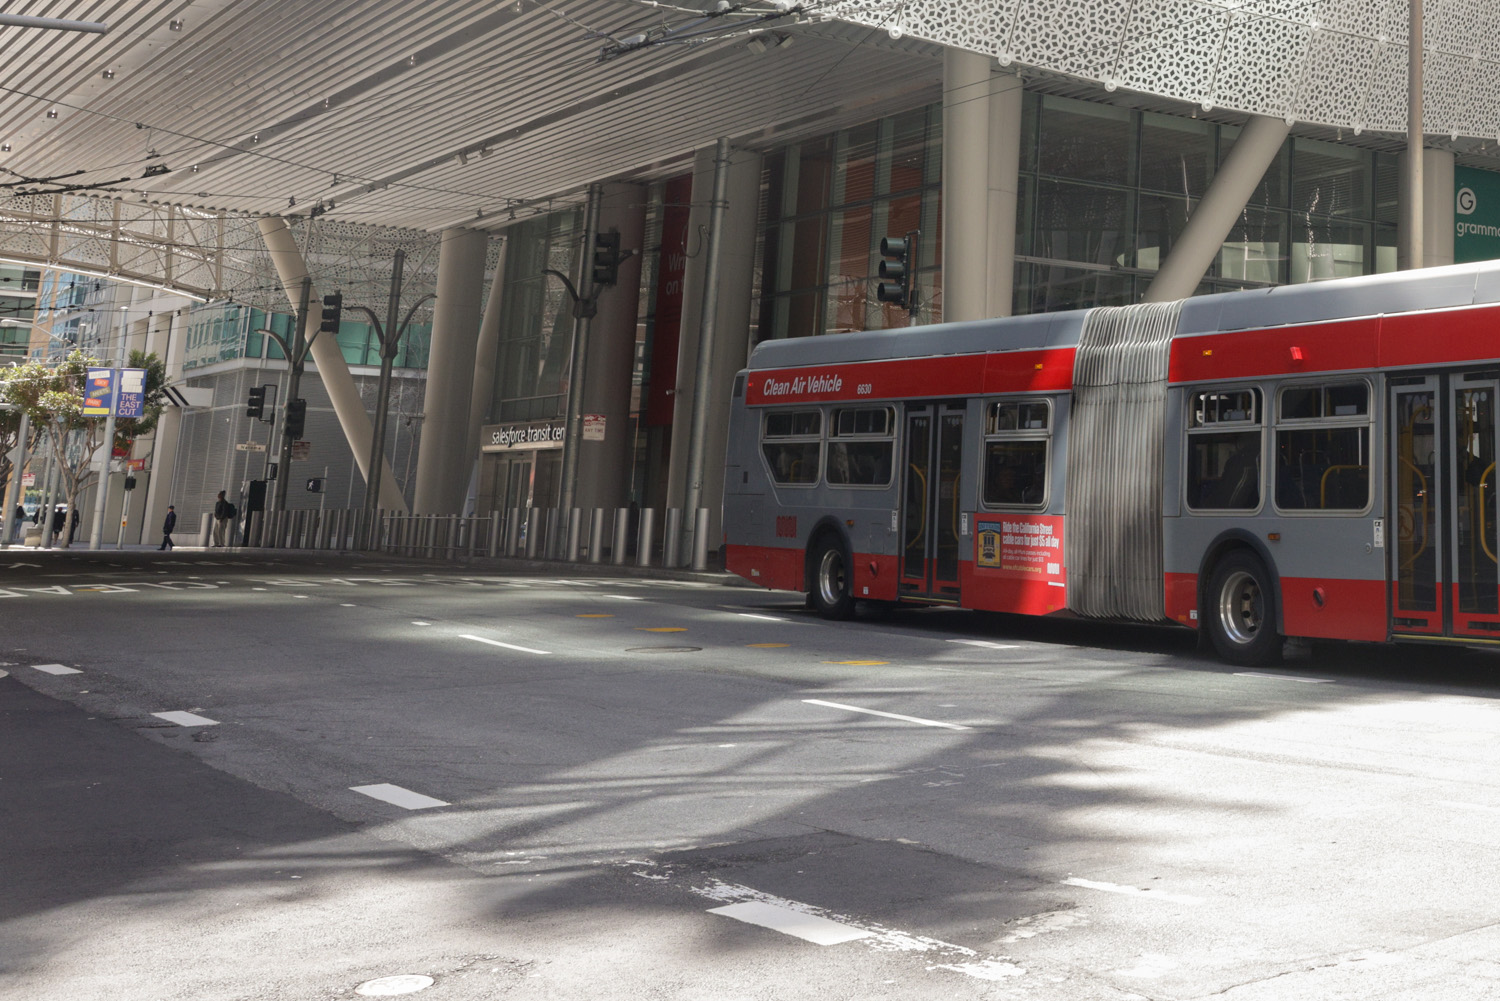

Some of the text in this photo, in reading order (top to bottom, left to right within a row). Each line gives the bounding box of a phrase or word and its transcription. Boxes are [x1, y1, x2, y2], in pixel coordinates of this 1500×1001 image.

[763, 374, 843, 396] Clean Air Vehicle
[856, 384, 872, 394] 6630
[491, 423, 565, 447] salesforce transit cen
